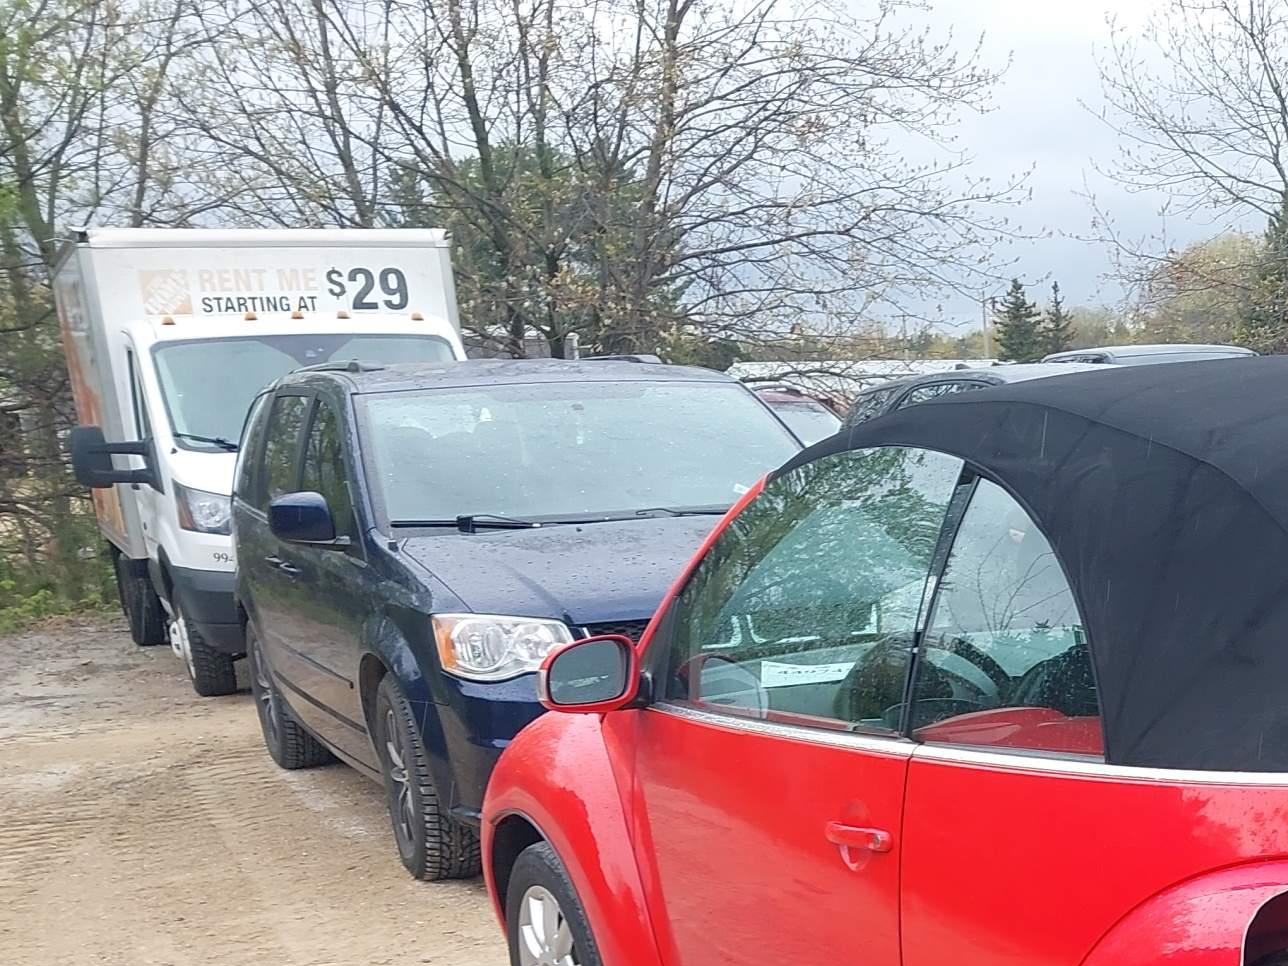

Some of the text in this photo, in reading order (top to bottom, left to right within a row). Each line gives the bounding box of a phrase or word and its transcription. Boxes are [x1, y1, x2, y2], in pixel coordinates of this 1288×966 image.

[200, 269, 318, 291] RENT ME
[326, 267, 408, 310] $29
[202, 296, 317, 313] STARTING AT
